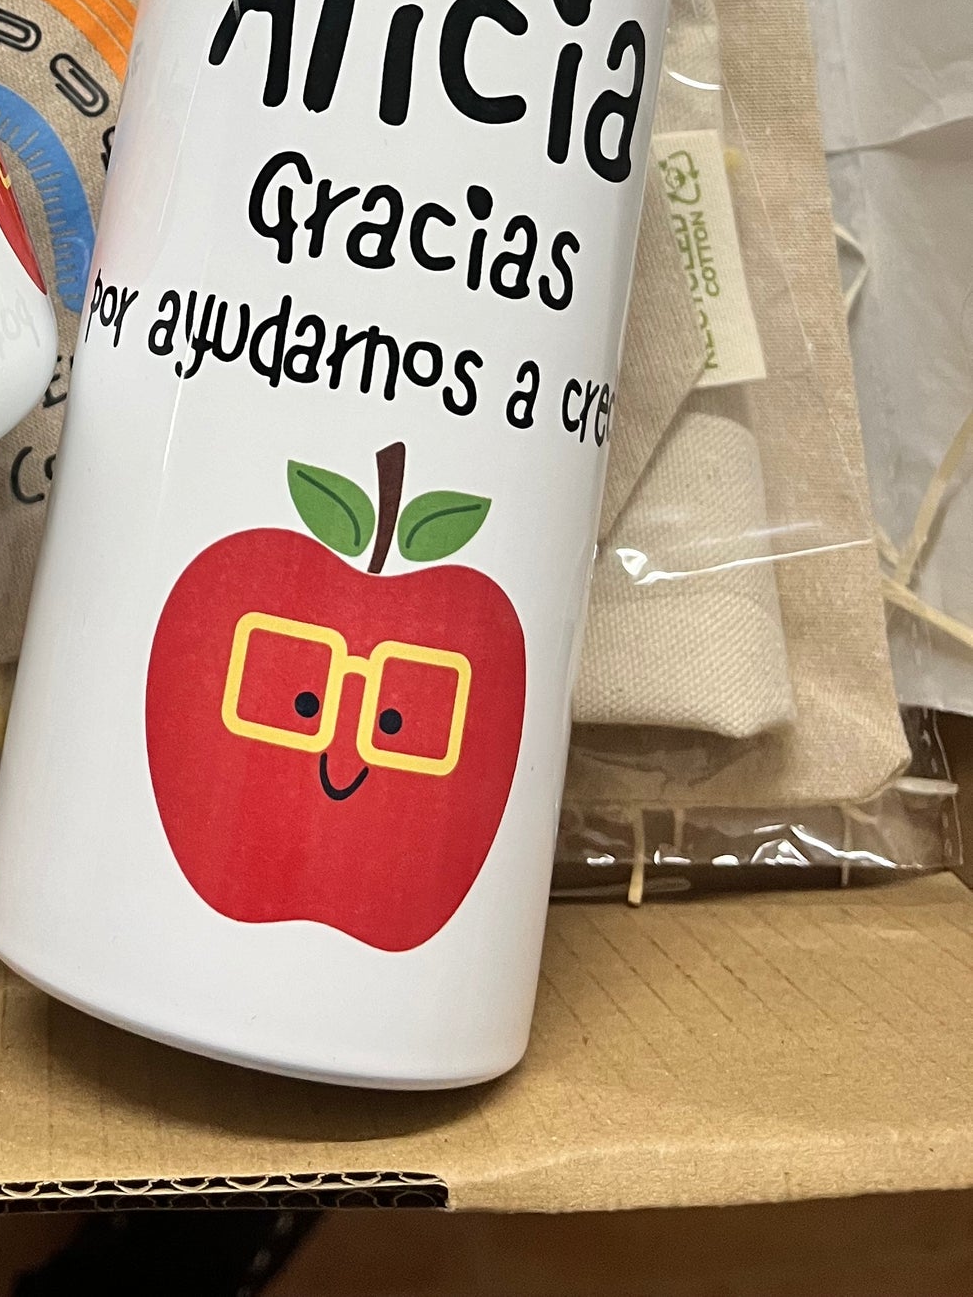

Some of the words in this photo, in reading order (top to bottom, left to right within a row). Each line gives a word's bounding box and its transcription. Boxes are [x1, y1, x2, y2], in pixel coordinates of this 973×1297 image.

[248, 150, 581, 311] Gracias
[689, 210, 720, 298] COTTON
[147, 288, 484, 417] ayudarnos
[505, 360, 540, 430] a
